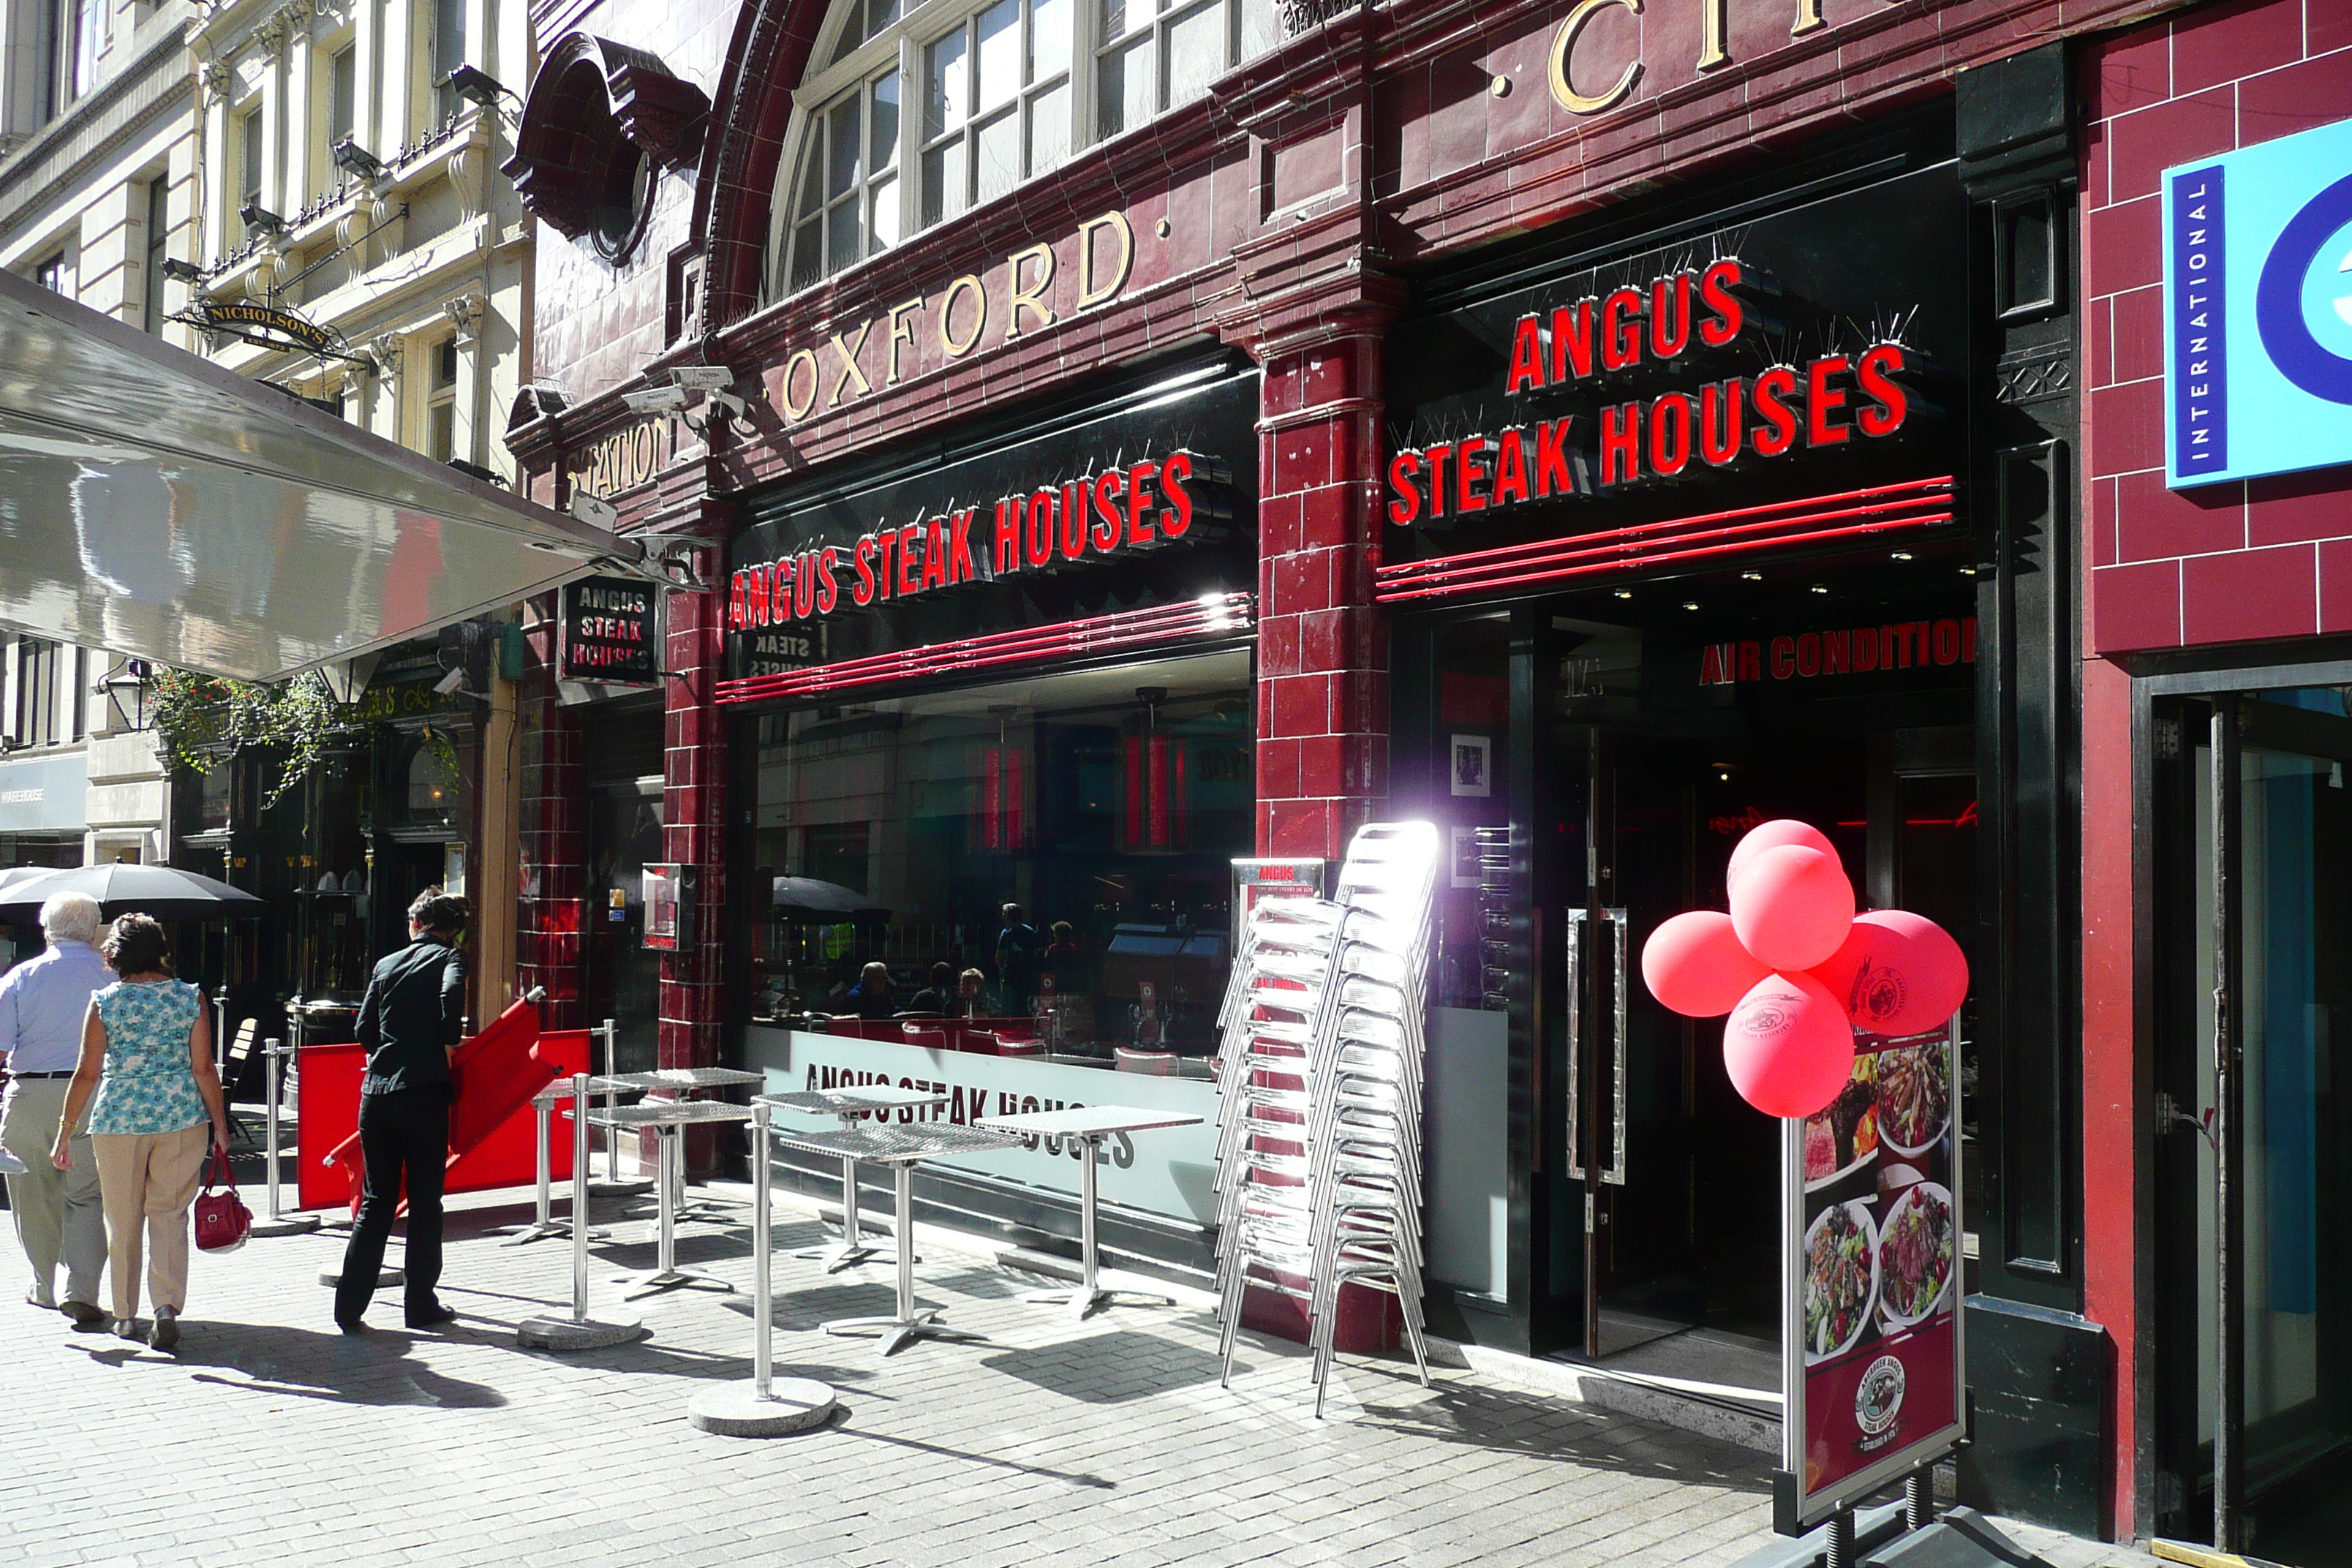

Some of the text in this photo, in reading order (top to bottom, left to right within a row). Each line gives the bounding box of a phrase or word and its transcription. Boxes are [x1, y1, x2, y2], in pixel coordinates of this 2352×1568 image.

[210, 306, 325, 345] NICHOLSON'S
[783, 210, 1135, 421] OXFORD
[1504, 259, 1746, 396] ANGUS
[2188, 183, 2209, 460] INTERNATIONAL
[647, 392, 669, 401] PHOTON
[1387, 341, 1910, 527] STEAK HOUSES
[728, 452, 1193, 634] ANGUS STEAK HOUSES
[578, 587, 646, 614] ANGUS
[581, 615, 642, 641] STEAK
[573, 643, 649, 670] HOUSES
[1698, 640, 1761, 686] AIR
[1, 789, 44, 804] WAREHOUSE
[1259, 865, 1294, 881] ANGUS
